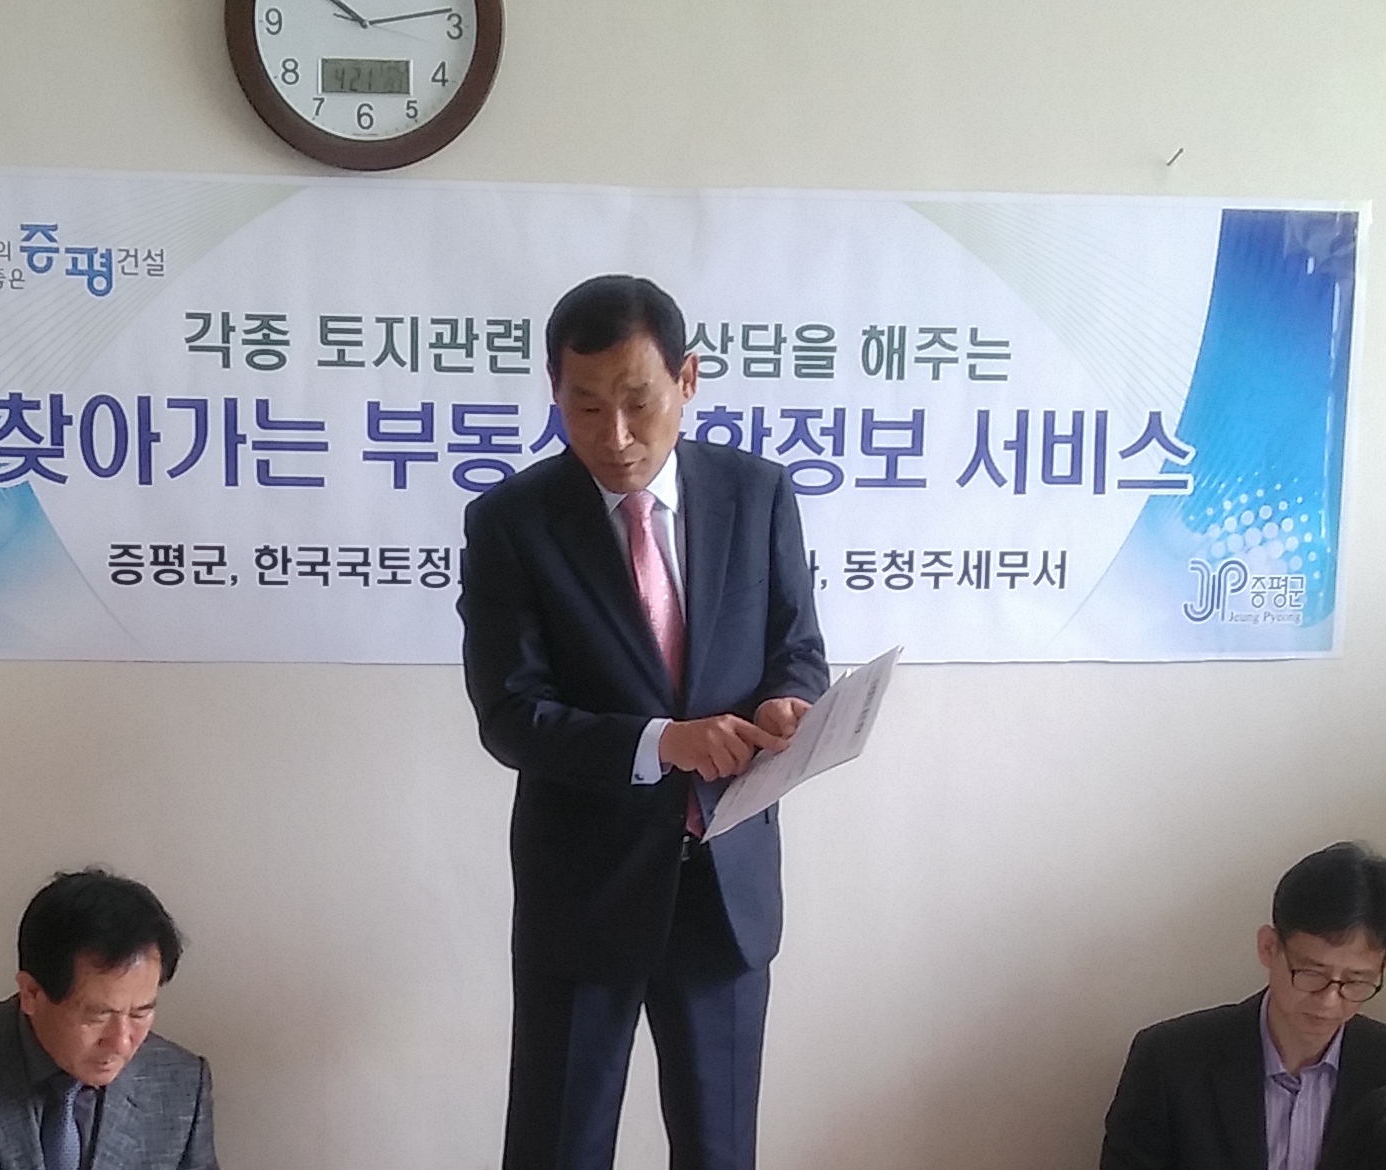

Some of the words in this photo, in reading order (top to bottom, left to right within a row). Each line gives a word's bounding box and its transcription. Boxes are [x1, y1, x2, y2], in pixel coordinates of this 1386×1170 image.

[265, 8, 283, 35] 9
[446, 13, 463, 40] 3
[281, 58, 300, 85] 8
[431, 62, 449, 86] 4
[313, 97, 325, 116] 7
[356, 103, 374, 129] 6
[405, 100, 418, 119] 5
[184, 311, 291, 371] 각종
[316, 314, 531, 374] 토지관련
[685, 322, 837, 379] 상담을
[861, 325, 1011, 381] 해주는
[956, 409, 1190, 495] 서비스
[107, 543, 238, 587] 증평군,
[843, 549, 1067, 590] 동청주세무서
[1250, 576, 1304, 608] 증평군
